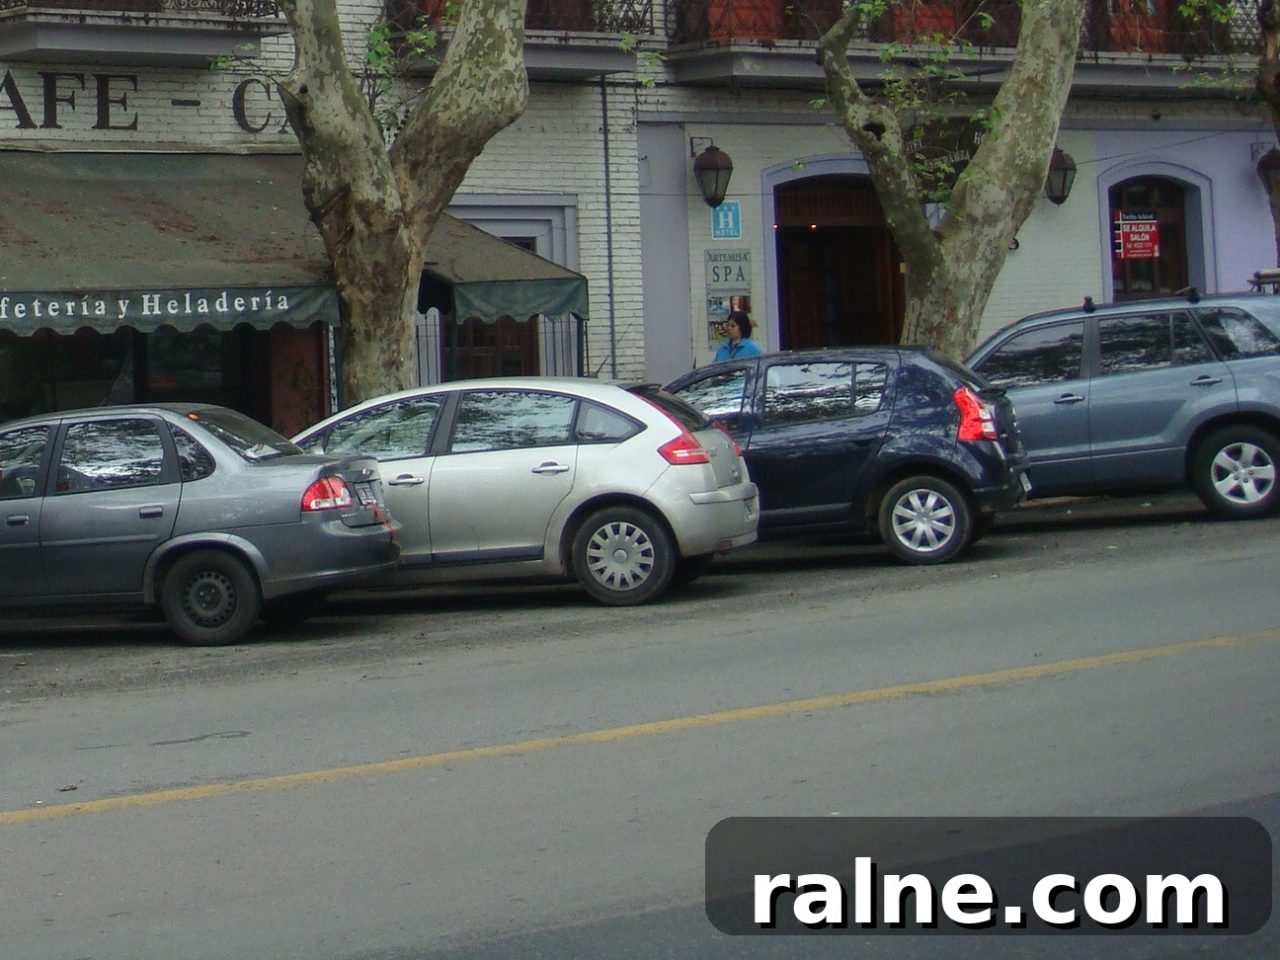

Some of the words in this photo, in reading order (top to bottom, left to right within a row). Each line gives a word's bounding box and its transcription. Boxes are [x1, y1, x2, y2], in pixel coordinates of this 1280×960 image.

[712, 265, 746, 283] SPA
[117, 298, 130, 319] y
[141, 290, 290, 316] Heladería
